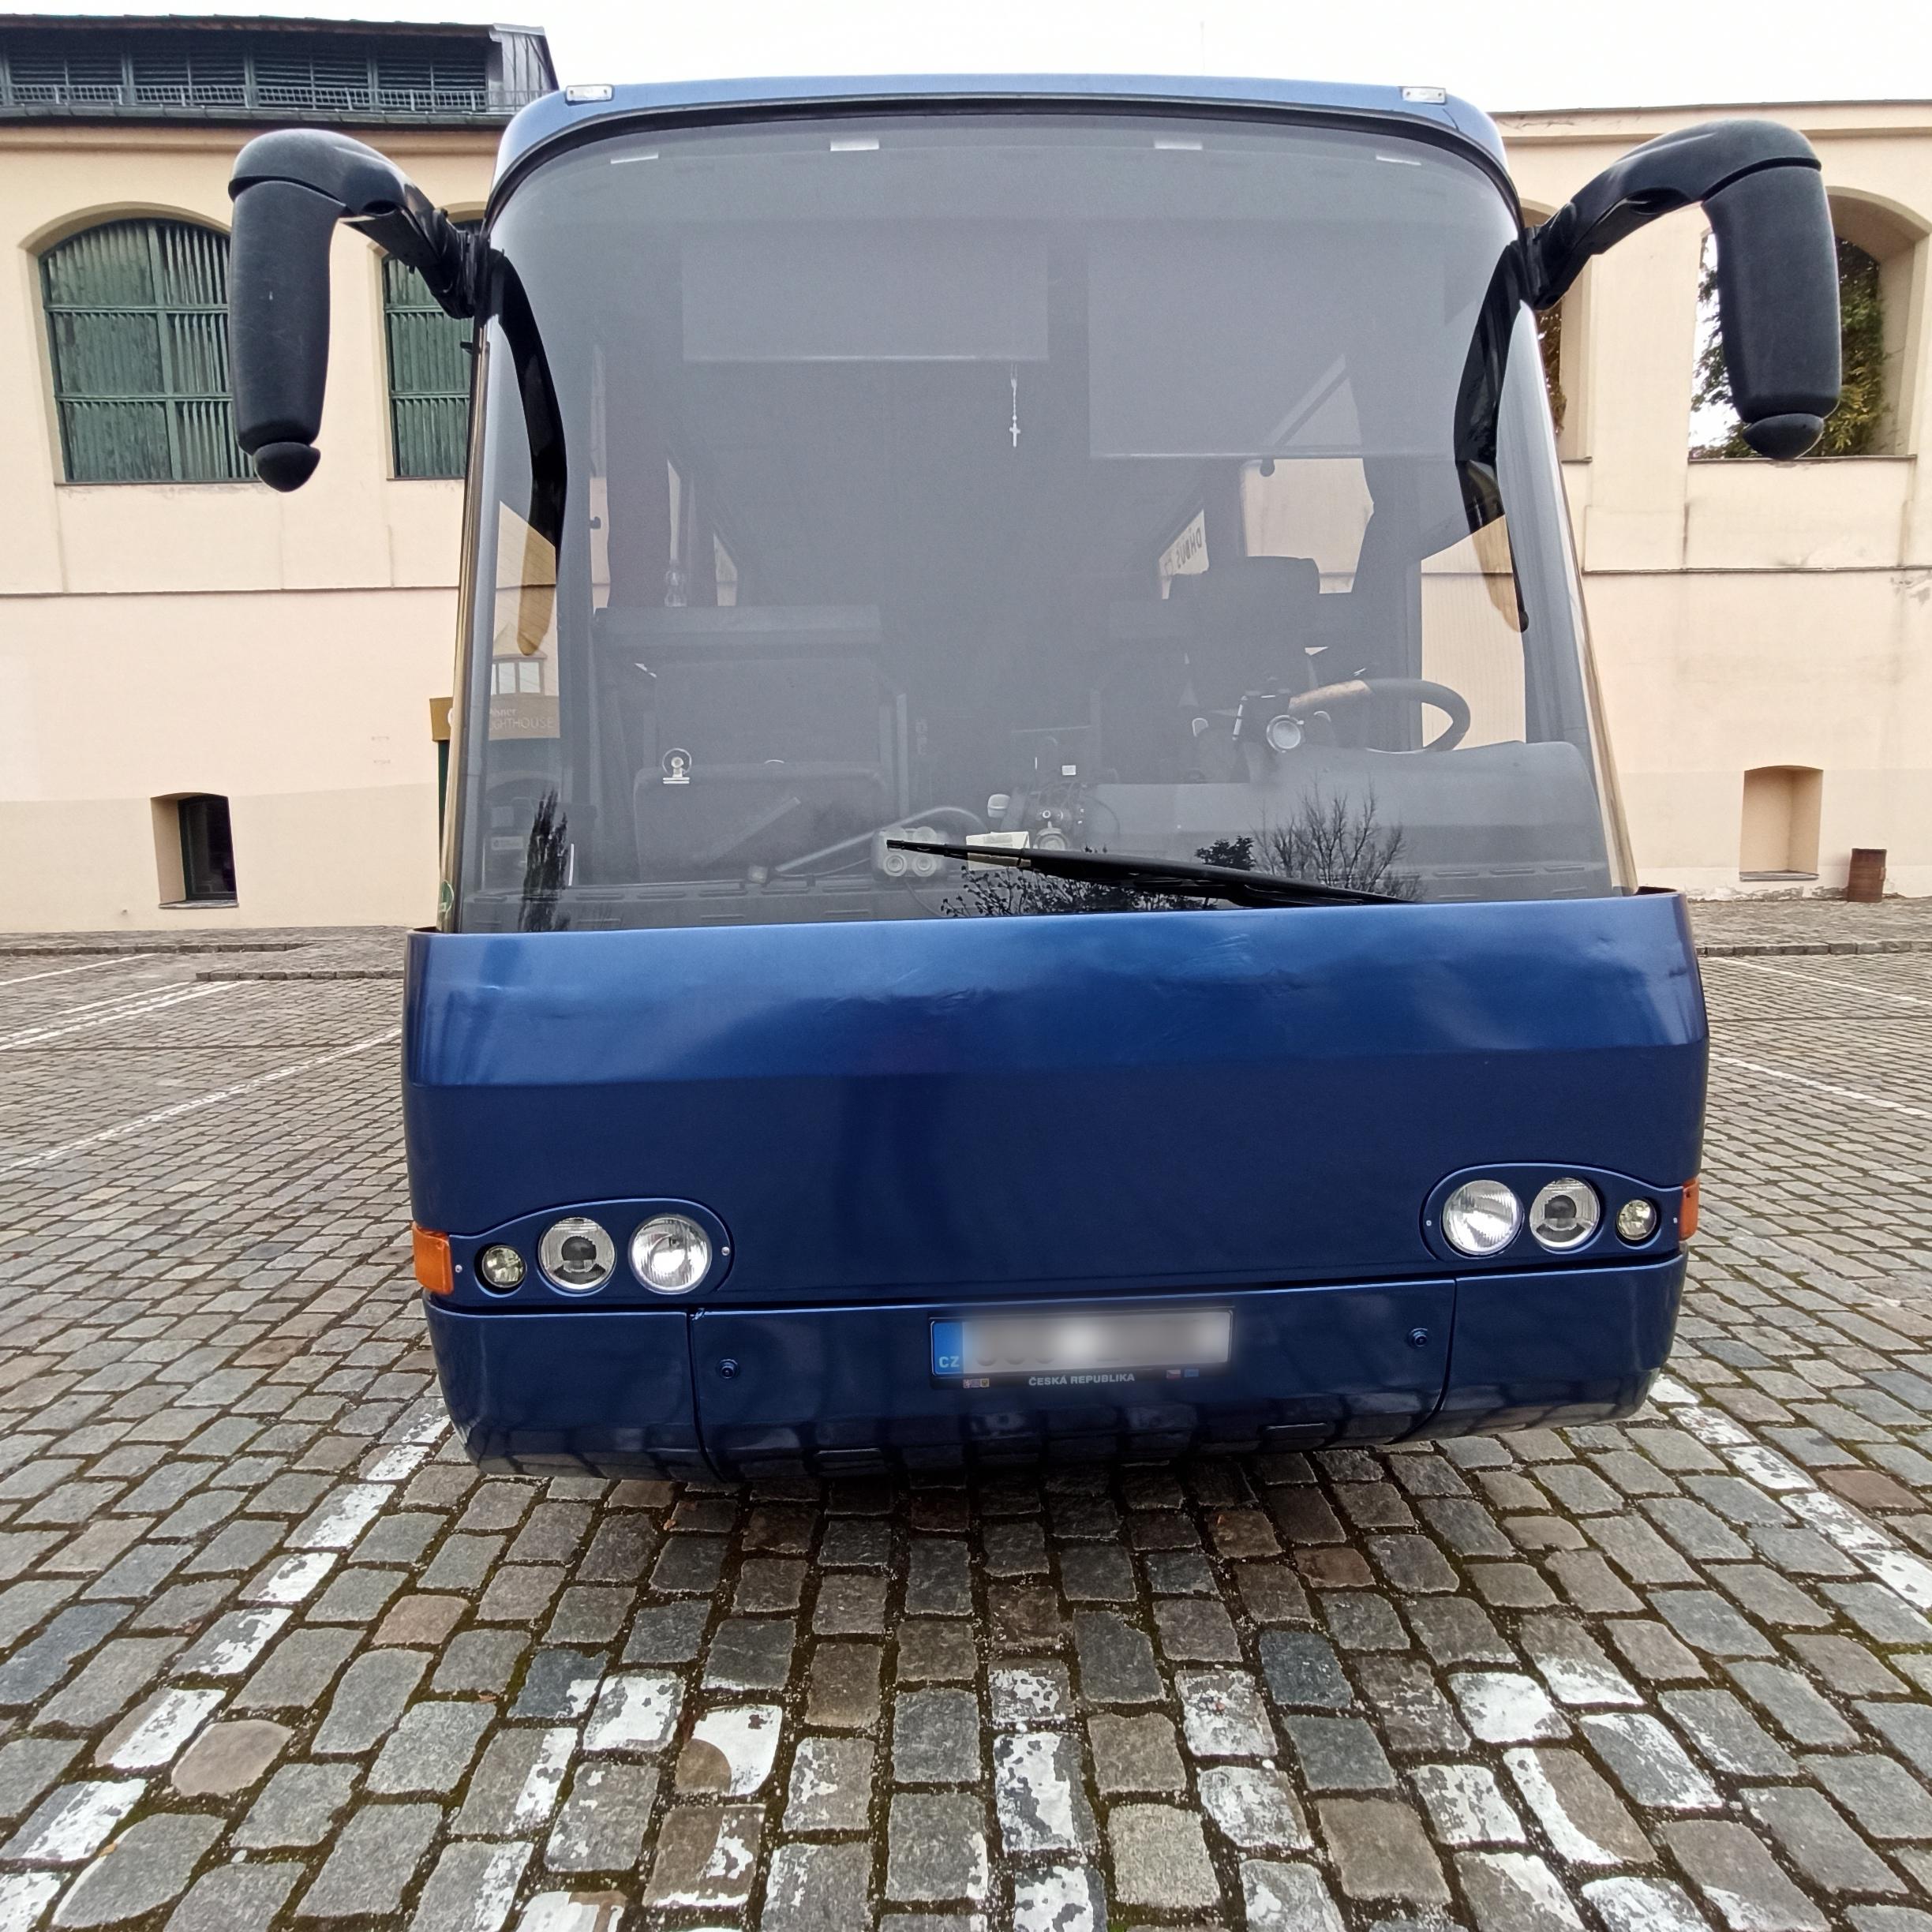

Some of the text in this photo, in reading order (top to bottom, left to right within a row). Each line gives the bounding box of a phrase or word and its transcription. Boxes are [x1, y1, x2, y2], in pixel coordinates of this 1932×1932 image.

[939, 1356, 960, 1368] CZ
[1028, 1373, 1135, 1386] ČESKÁ REPUBLIKA
